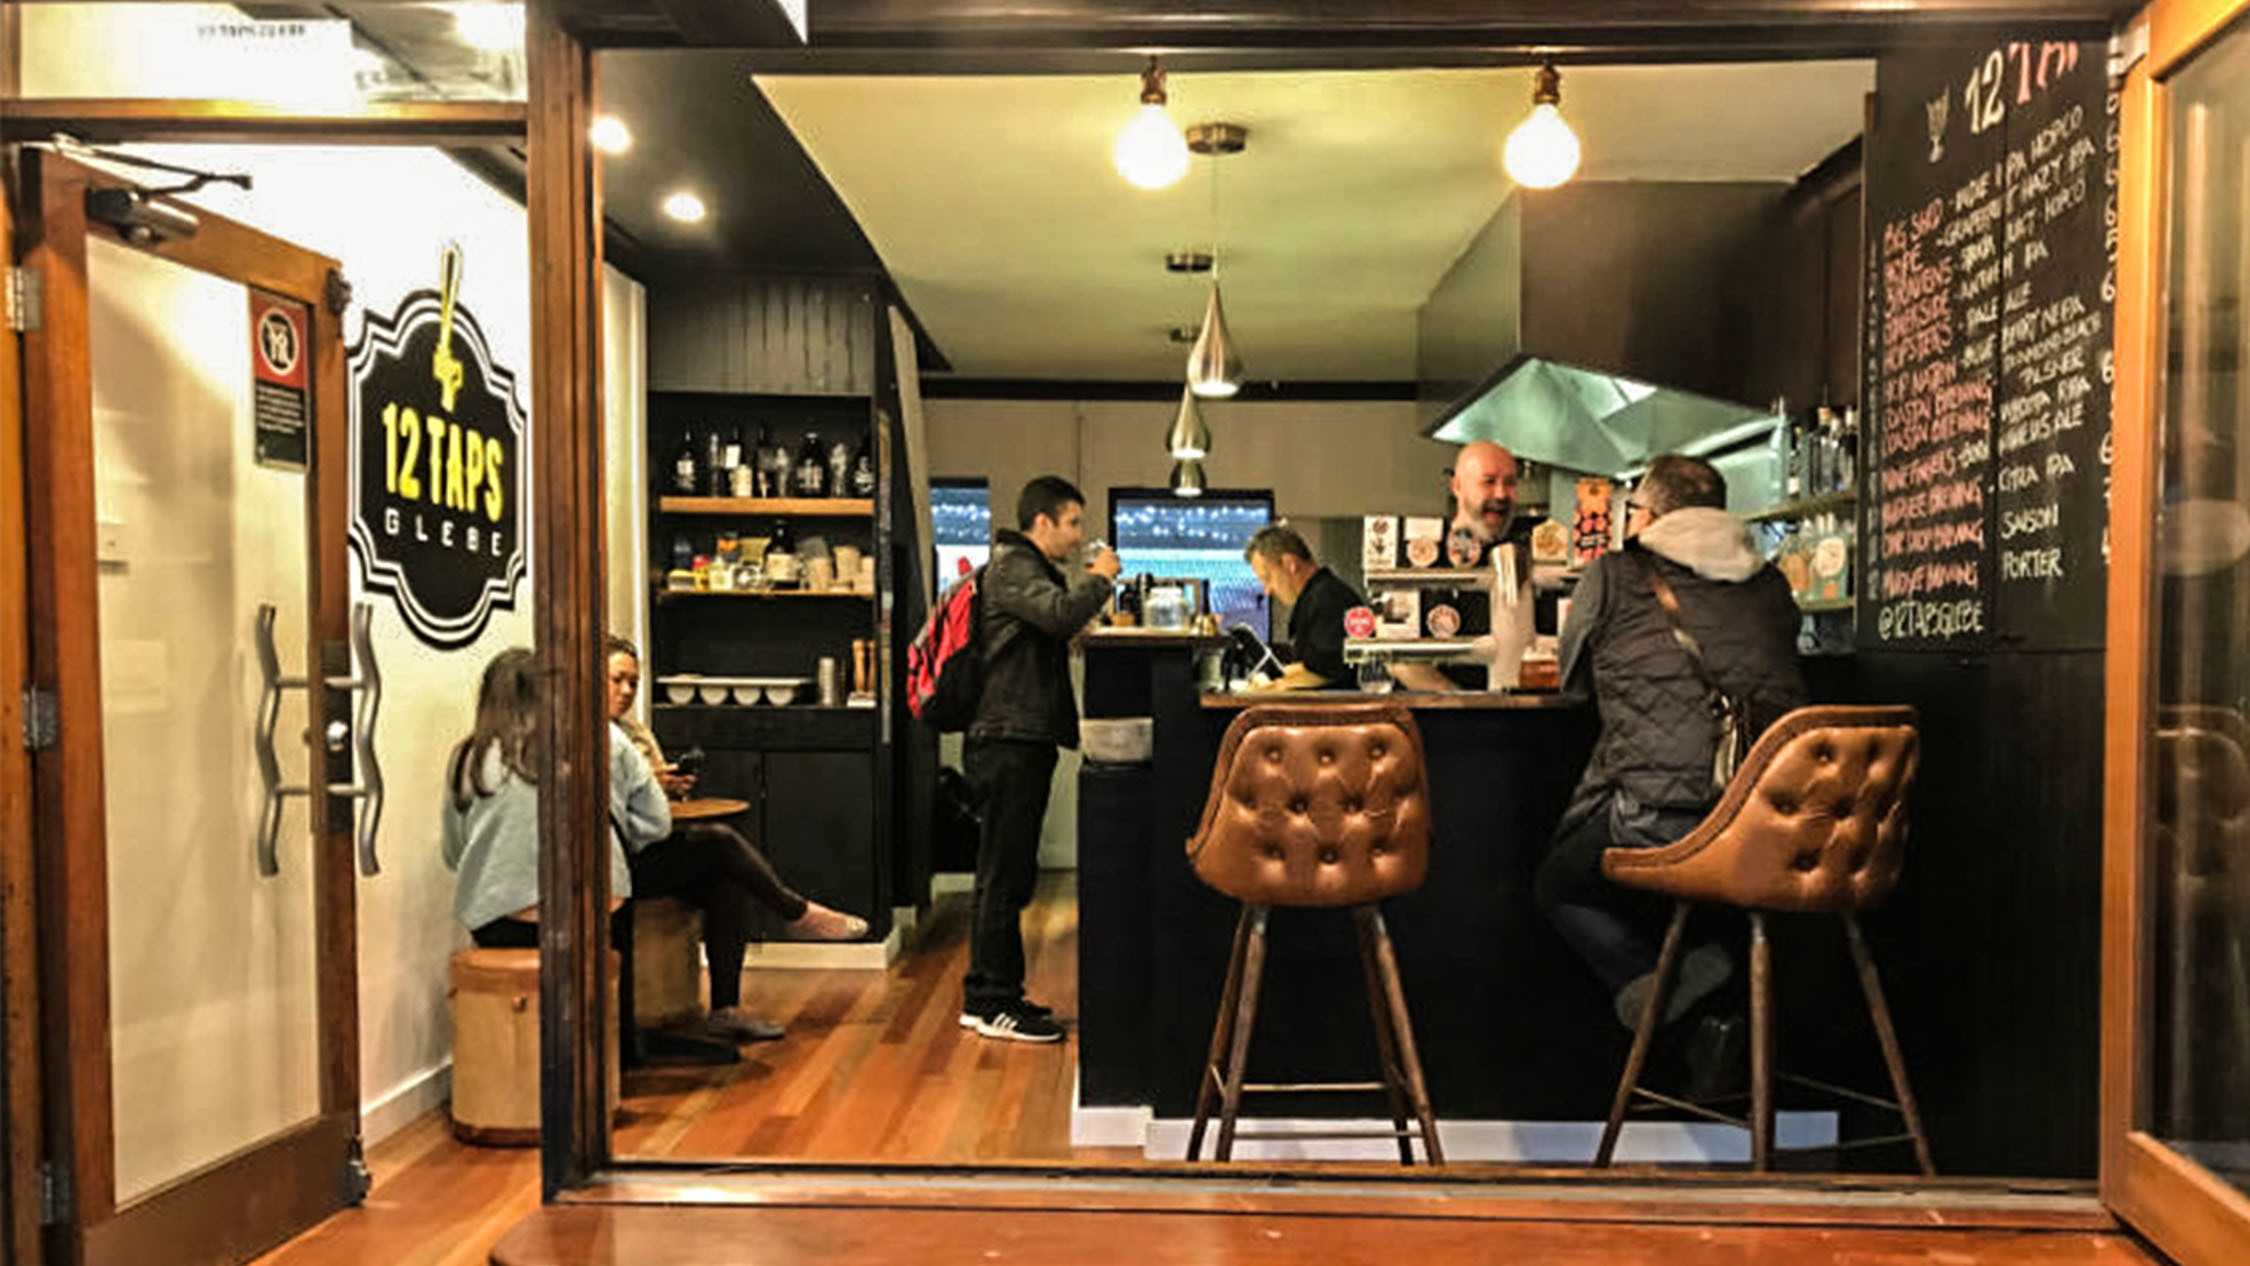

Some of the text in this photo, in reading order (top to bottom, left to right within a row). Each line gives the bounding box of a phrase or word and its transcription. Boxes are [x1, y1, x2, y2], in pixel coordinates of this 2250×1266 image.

[1965, 50, 2005, 134] 12
[382, 401, 421, 499] 12
[426, 415, 503, 523] TAPS
[384, 507, 502, 556] GLEBE
[2002, 504, 2060, 539] SAISON
[2002, 549, 2063, 580] PORTER
